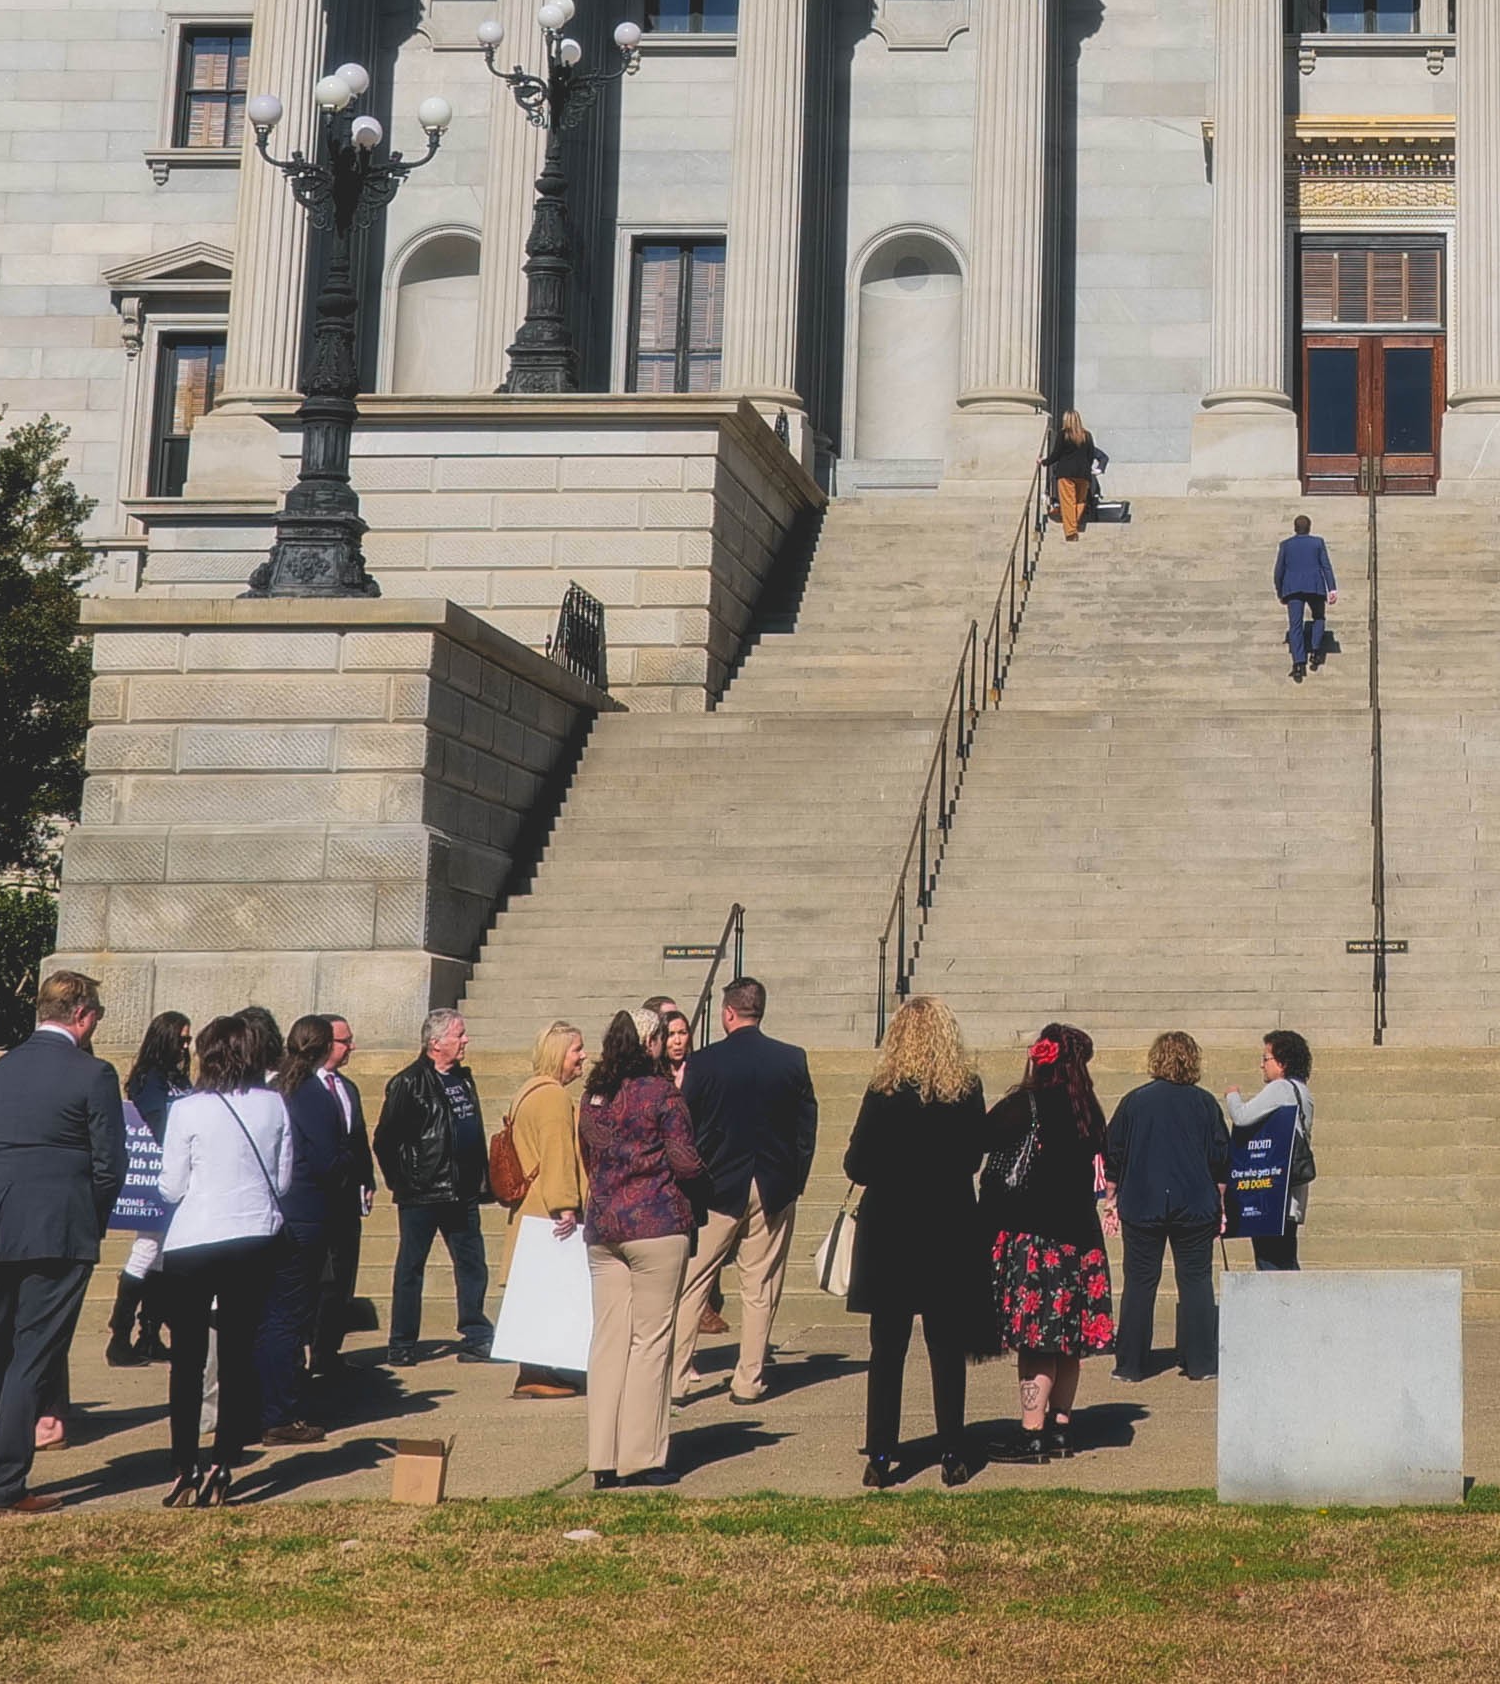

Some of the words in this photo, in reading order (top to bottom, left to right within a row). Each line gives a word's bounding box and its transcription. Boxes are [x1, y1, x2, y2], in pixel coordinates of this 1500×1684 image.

[1247, 1139, 1272, 1150] mom
[129, 1157, 146, 1169] ith
[1231, 1169, 1244, 1179] One
[1244, 1168, 1257, 1177] who
[1271, 1166, 1282, 1175] the
[1237, 1179, 1250, 1190] JOB
[116, 1197, 145, 1207] MOMS
[116, 1206, 159, 1217] LIBERTY
